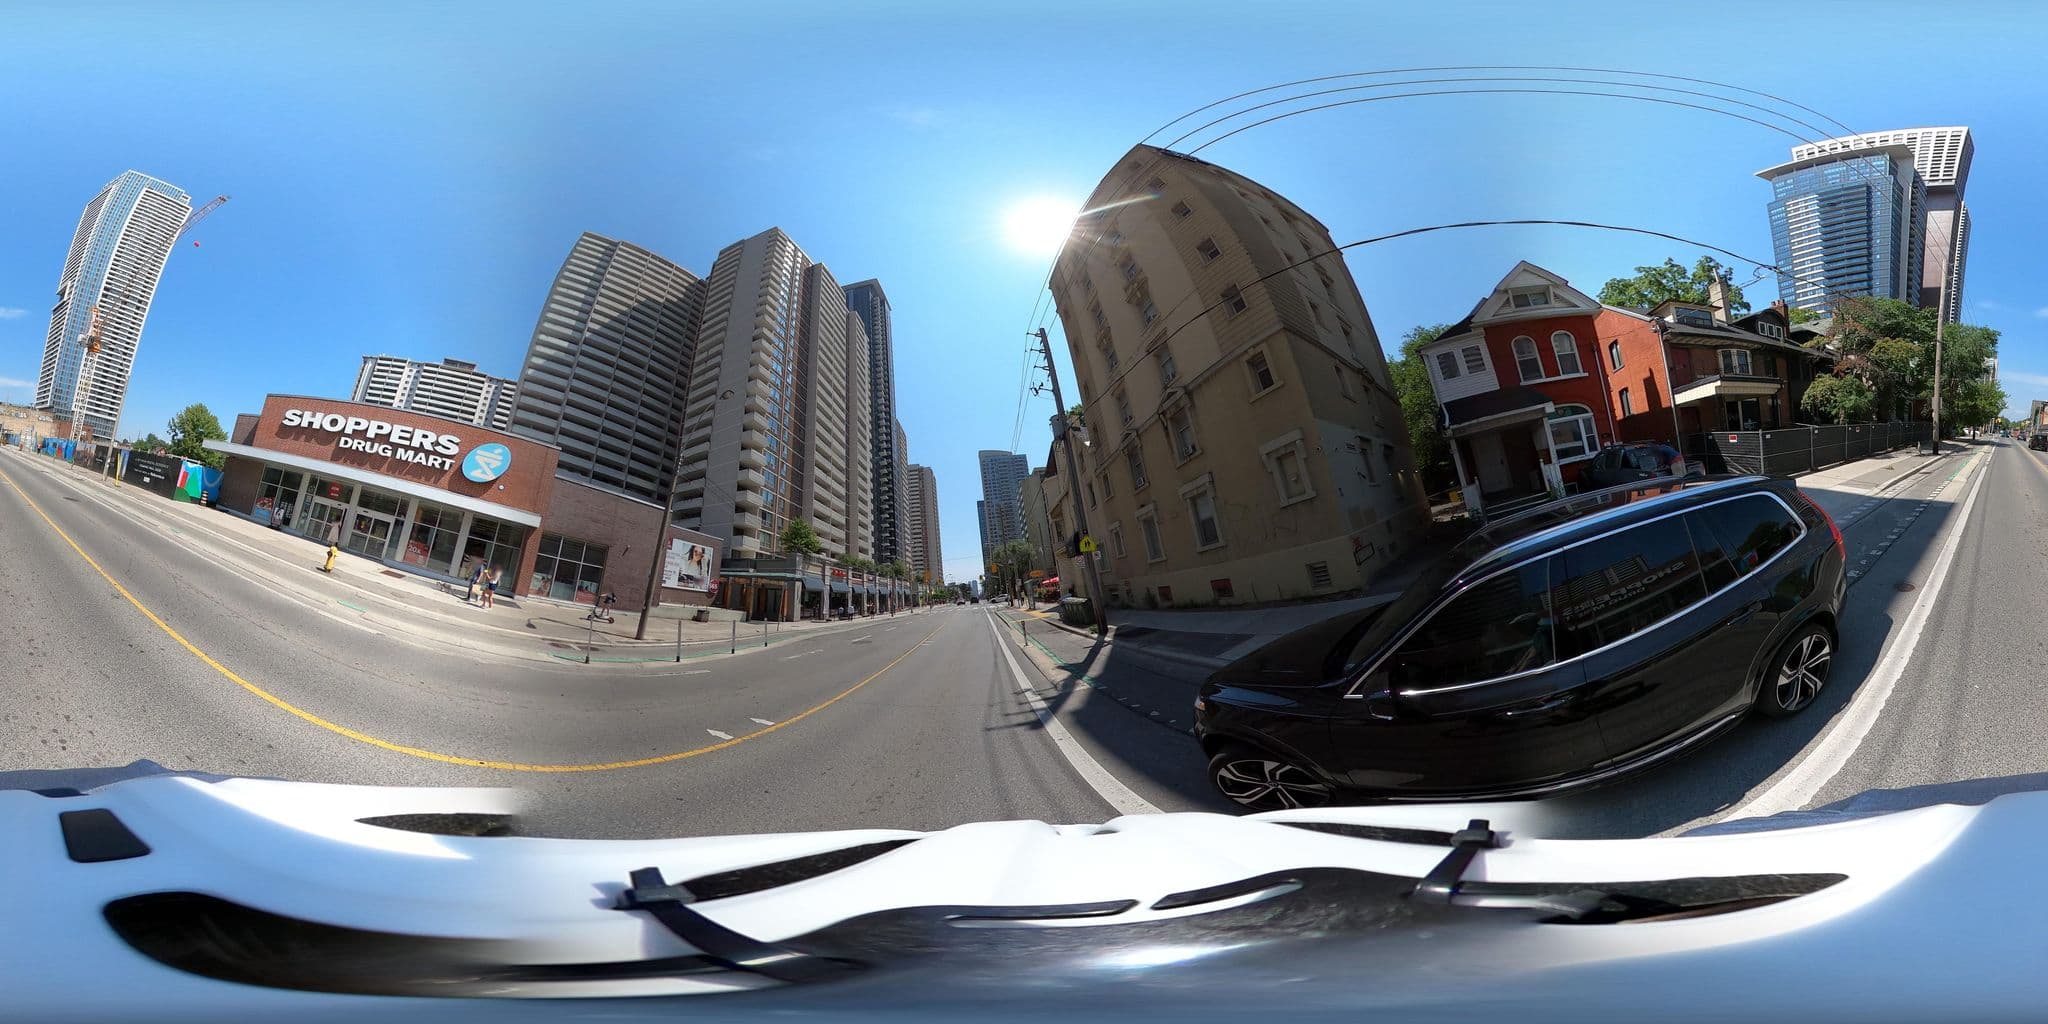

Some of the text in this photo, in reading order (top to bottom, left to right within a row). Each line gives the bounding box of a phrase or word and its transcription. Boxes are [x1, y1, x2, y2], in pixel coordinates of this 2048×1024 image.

[282, 409, 461, 456] SHOPPERS
[339, 436, 455, 471] DRUG MART
